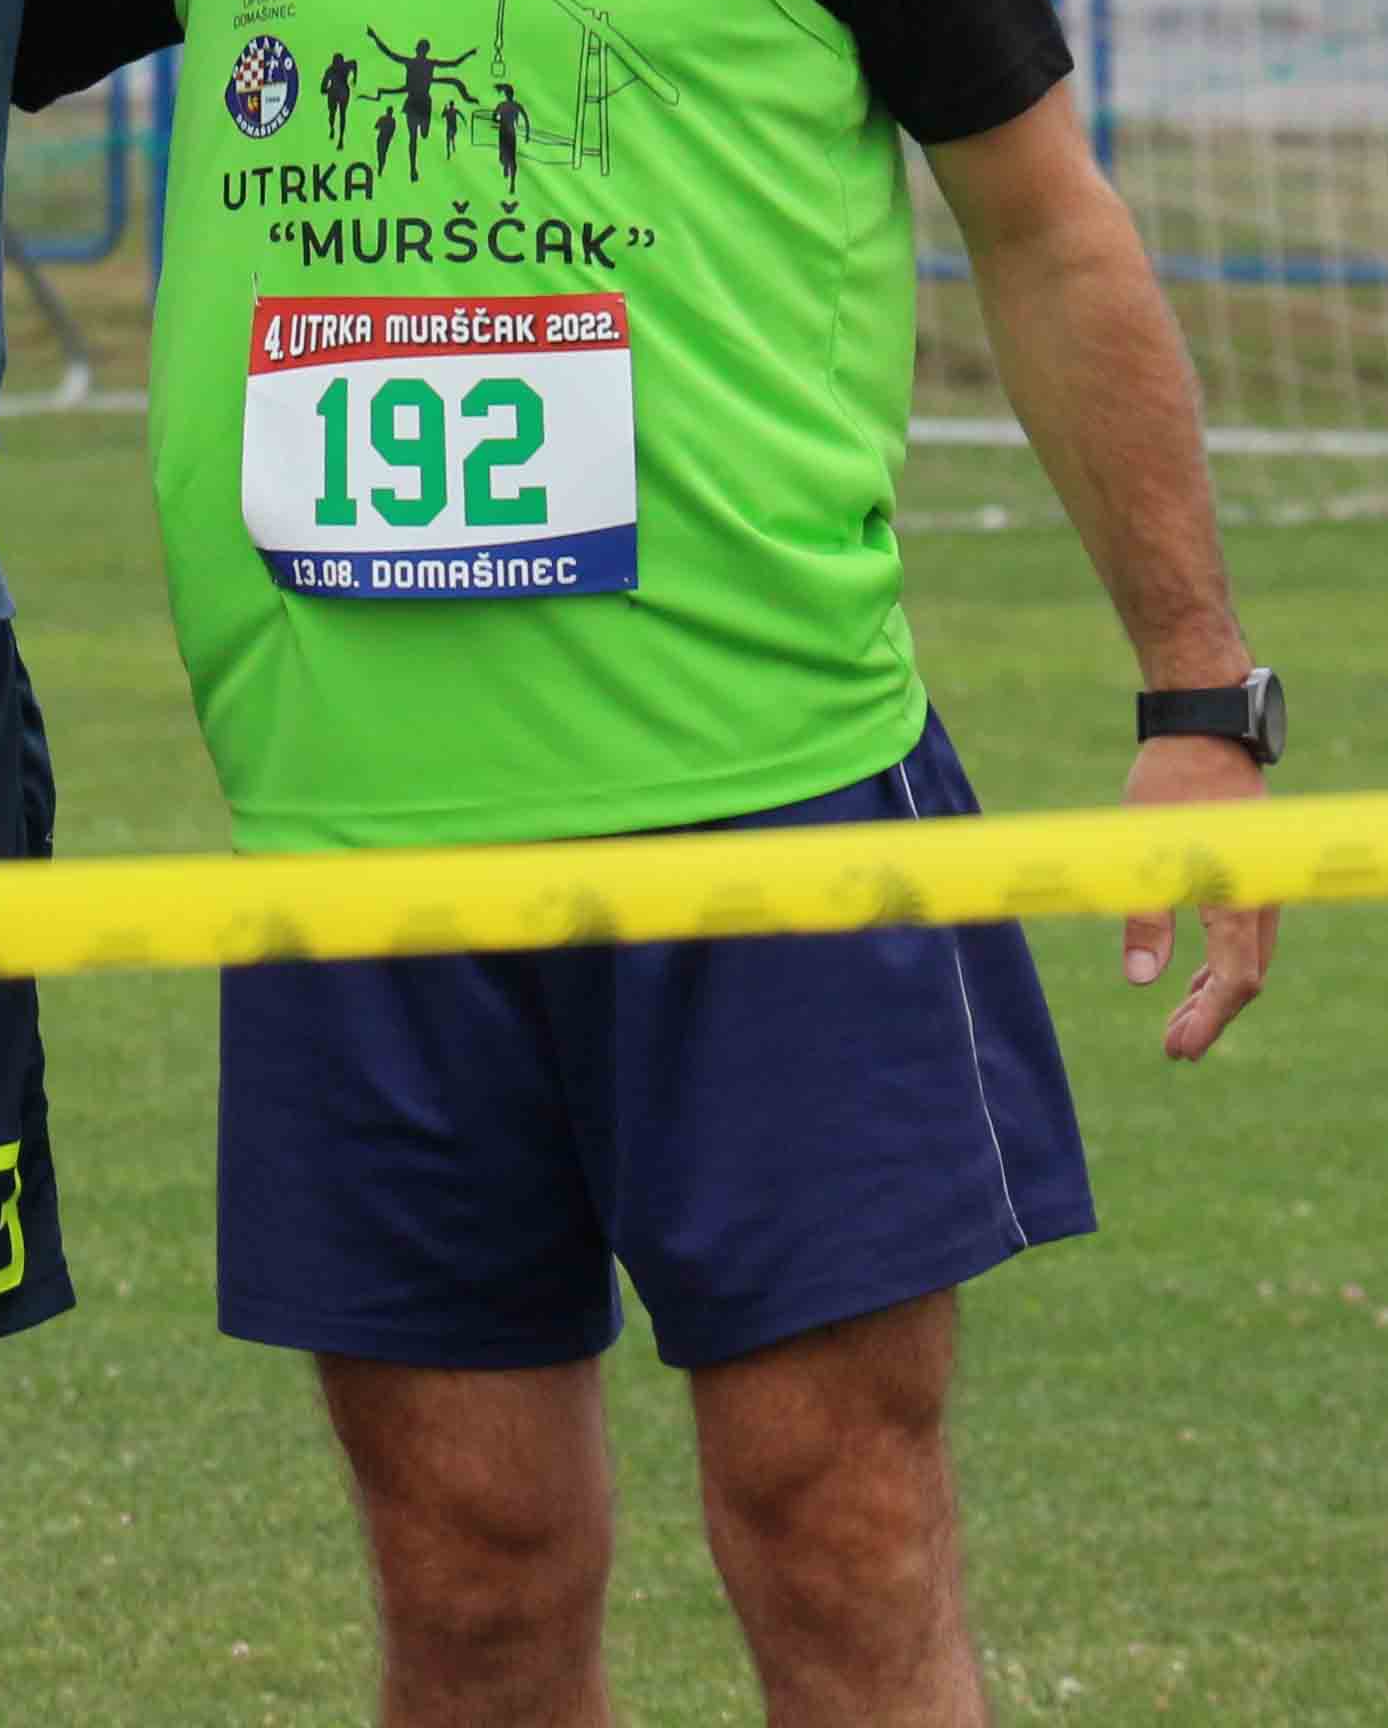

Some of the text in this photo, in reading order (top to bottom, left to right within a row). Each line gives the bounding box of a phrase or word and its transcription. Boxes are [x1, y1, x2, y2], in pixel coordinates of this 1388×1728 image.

[224, 162, 373, 210] UTRKA
[264, 307, 620, 360] 4. UTRKA MURŠČAK 2022.
[315, 377, 548, 526] 192
[293, 552, 577, 589] 13.08. DOMAŠINEC
